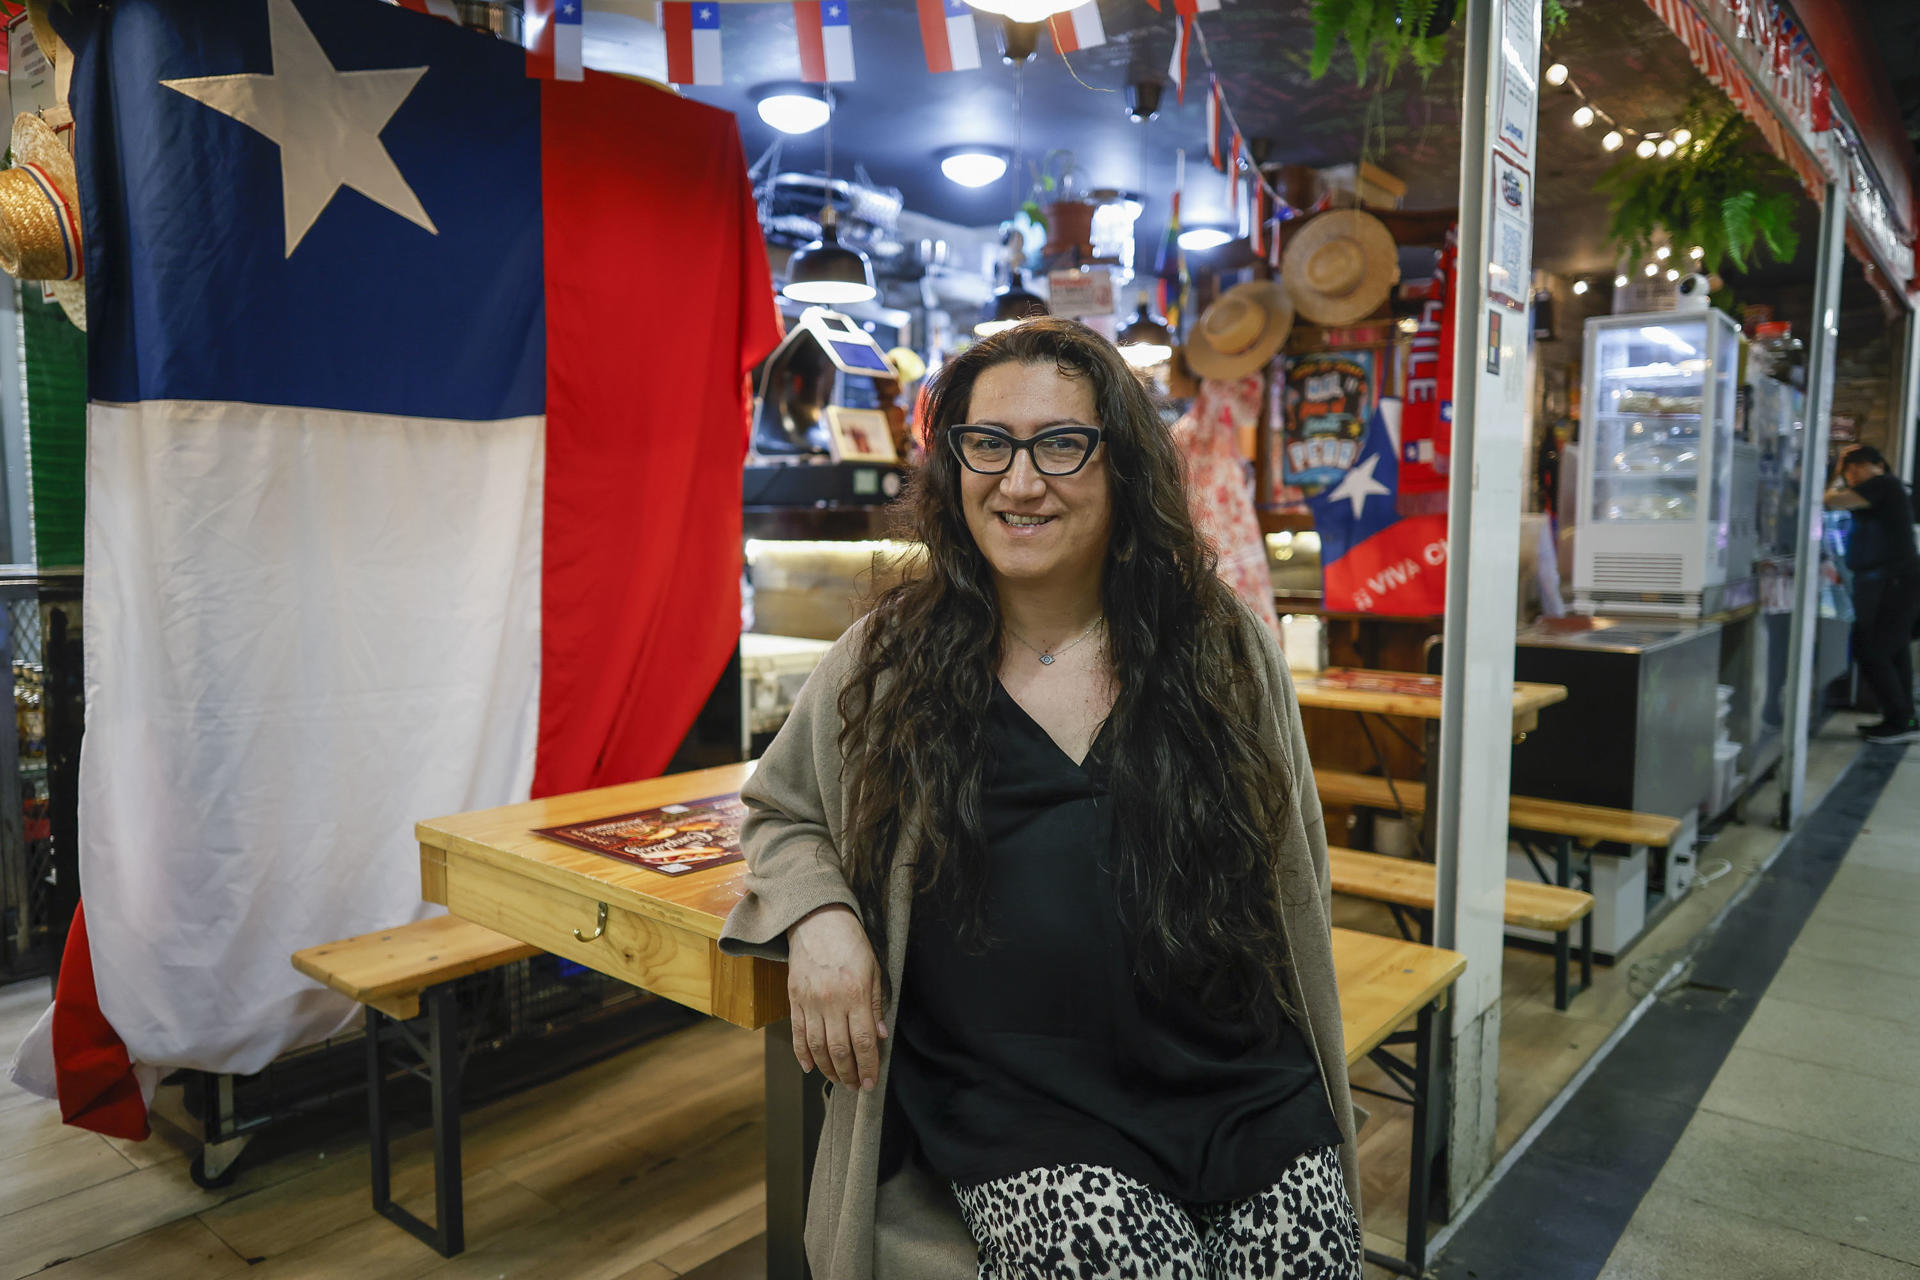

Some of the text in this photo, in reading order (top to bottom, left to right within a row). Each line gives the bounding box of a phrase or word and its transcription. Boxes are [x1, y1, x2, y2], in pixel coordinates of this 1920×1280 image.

[1407, 252, 1443, 404] HILE
[1366, 558, 1421, 595] VIVA
[1423, 538, 1448, 567] C
